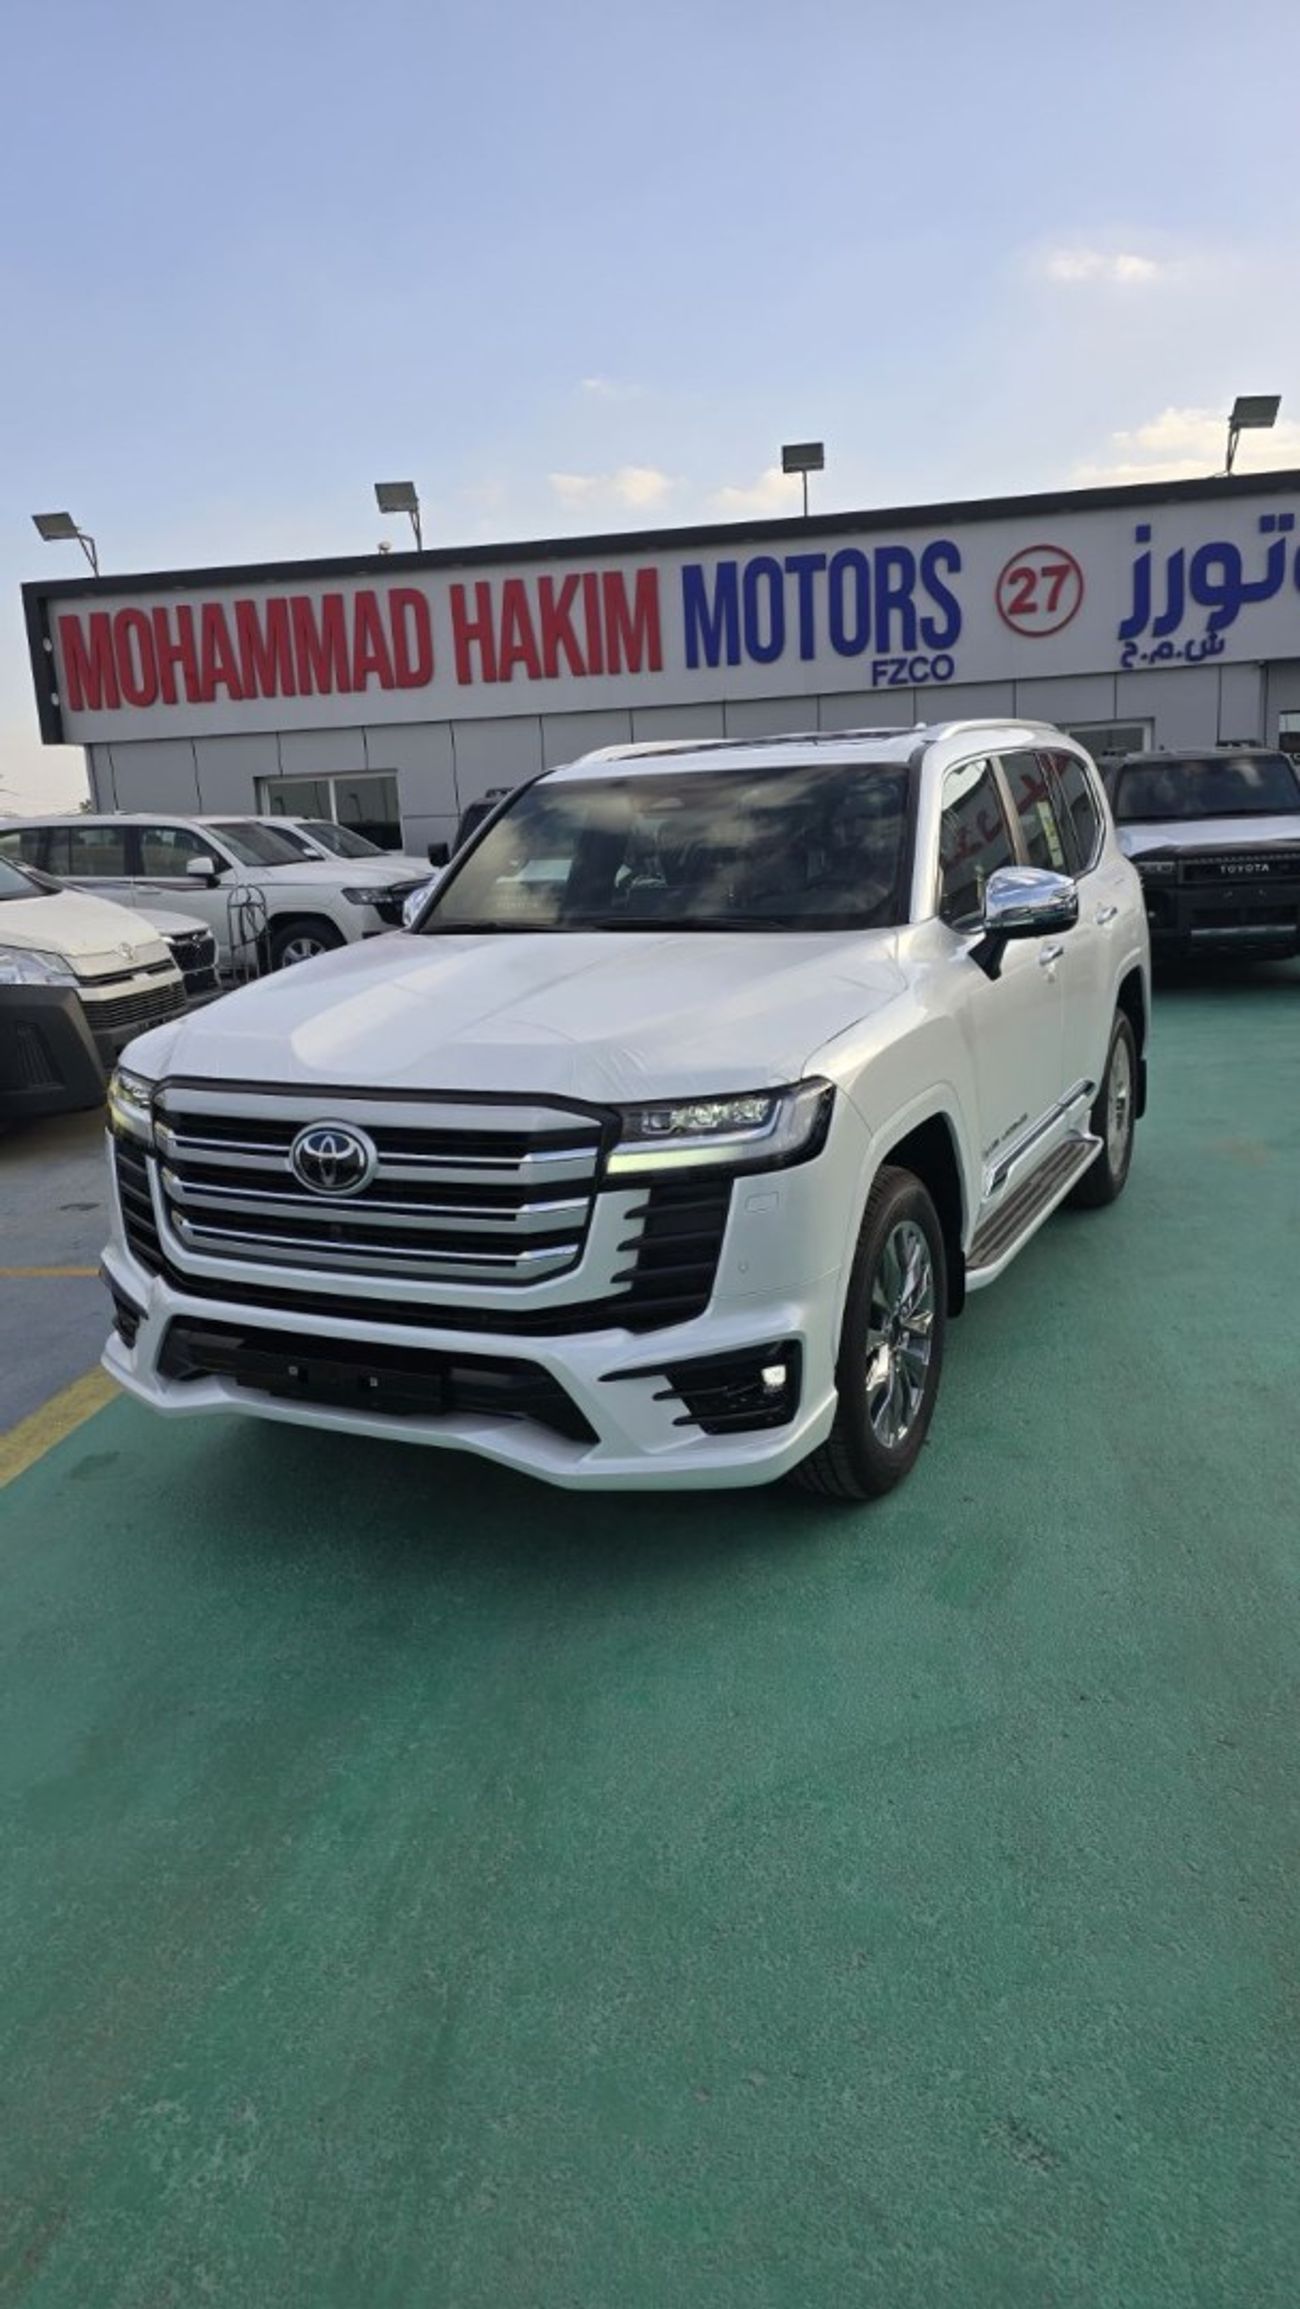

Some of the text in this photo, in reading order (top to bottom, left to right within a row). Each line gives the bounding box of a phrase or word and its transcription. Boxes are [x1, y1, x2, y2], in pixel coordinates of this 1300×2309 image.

[1007, 563, 1072, 616] 27
[1117, 513, 1300, 641] تورز
[59, 539, 962, 711] MOHAMMAD HAKIM MOTORS
[872, 653, 955, 687] FZCO
[1220, 863, 1270, 874] TOYOTA
